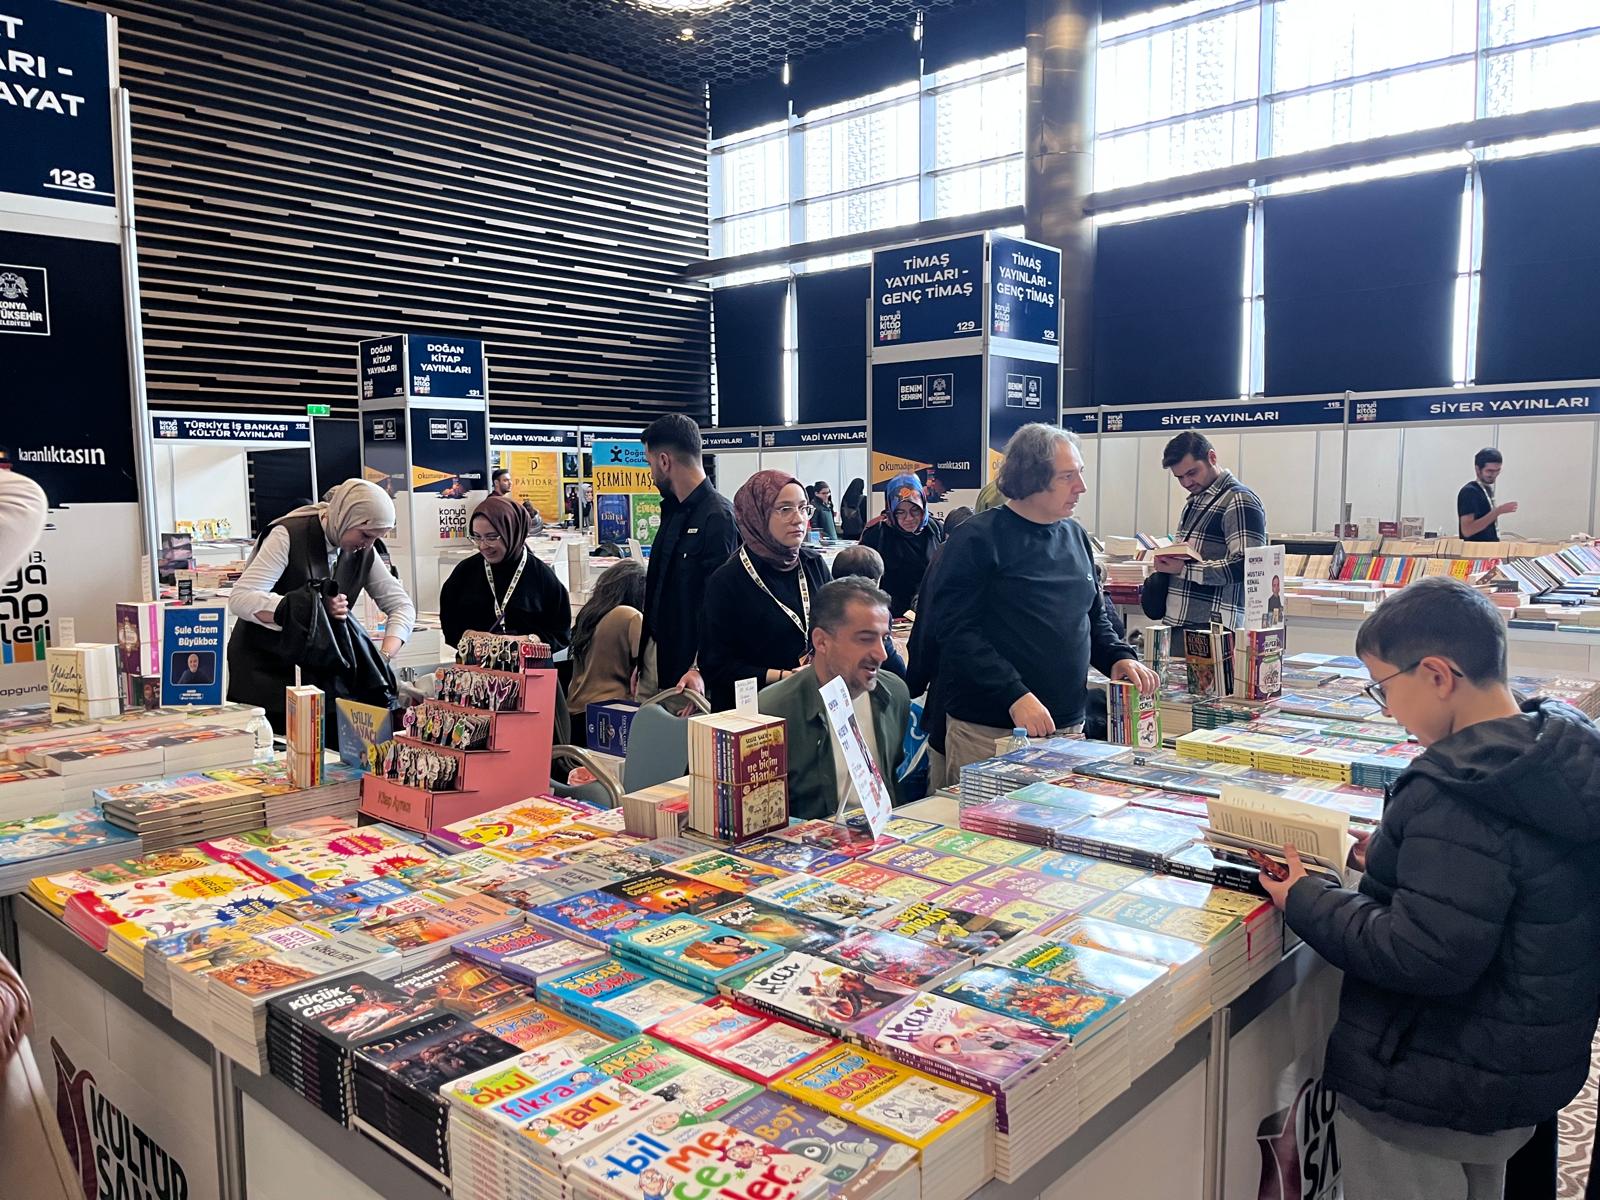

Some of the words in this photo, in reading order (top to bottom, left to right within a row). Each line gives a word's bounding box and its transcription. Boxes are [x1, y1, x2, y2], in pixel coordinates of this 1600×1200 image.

[49, 168, 96, 190] 128
[904, 253, 950, 271] TİMAŞ
[1012, 252, 1042, 271] TİMAŞ
[885, 268, 959, 289] YAYINLARI
[999, 266, 1047, 288] YAYINLARI
[882, 289, 923, 306] GENÇ
[926, 282, 973, 300] TİMAŞ
[996, 282, 1024, 301] GENÇ
[1026, 287, 1054, 308] TİMAŞ
[0, 309, 43, 322] ÜKŞEHİR
[956, 320, 975, 331] 129
[370, 345, 392, 355] DOĞAN
[372, 355, 391, 365] KİTAP
[427, 344, 464, 355] DOĞAN
[431, 353, 461, 364] KİTAP
[367, 364, 397, 375] YAYINLARI
[420, 363, 471, 375] YAYINLARI
[900, 384, 923, 394] BENİM
[1430, 402, 1484, 415] SİYER
[1490, 397, 1589, 412] YAYINLARI
[184, 420, 230, 430] TÜRKİYE
[232, 421, 241, 431] İŞ
[244, 423, 288, 431] BANKASI
[1161, 413, 1201, 426] SİYER
[1205, 411, 1279, 424] YAYINLARI
[189, 429, 231, 438] KÜLTÜR
[233, 431, 284, 439] YAYINLARI
[801, 432, 831, 443] VADİ
[18, 446, 106, 465] karanlıktasın
[596, 470, 632, 491] ŞERMİN
[635, 472, 655, 490] YAŞ
[439, 516, 467, 527] kitap
[174, 626, 192, 636] Şule
[193, 625, 218, 634] Gizem
[178, 636, 218, 649] Büyükboz
[896, 902, 931, 924] SEYİT
[897, 908, 951, 936] ONBAŞI
[564, 962, 627, 990] SAKAR
[577, 971, 645, 998] BORA
[288, 985, 348, 1011] KÜÇÜK
[301, 995, 357, 1020] CASUS
[491, 1011, 550, 1037] AKAR
[597, 1045, 658, 1076] AKAR
[802, 1054, 872, 1090] SAKAR
[824, 1063, 898, 1100] BORA
[472, 1073, 535, 1107] okul
[89, 1084, 189, 1200] KÜLTÜR
[665, 1129, 722, 1173] me
[603, 1131, 672, 1176] bil
[672, 1165, 732, 1200] ce
[719, 1163, 790, 1200] ler
